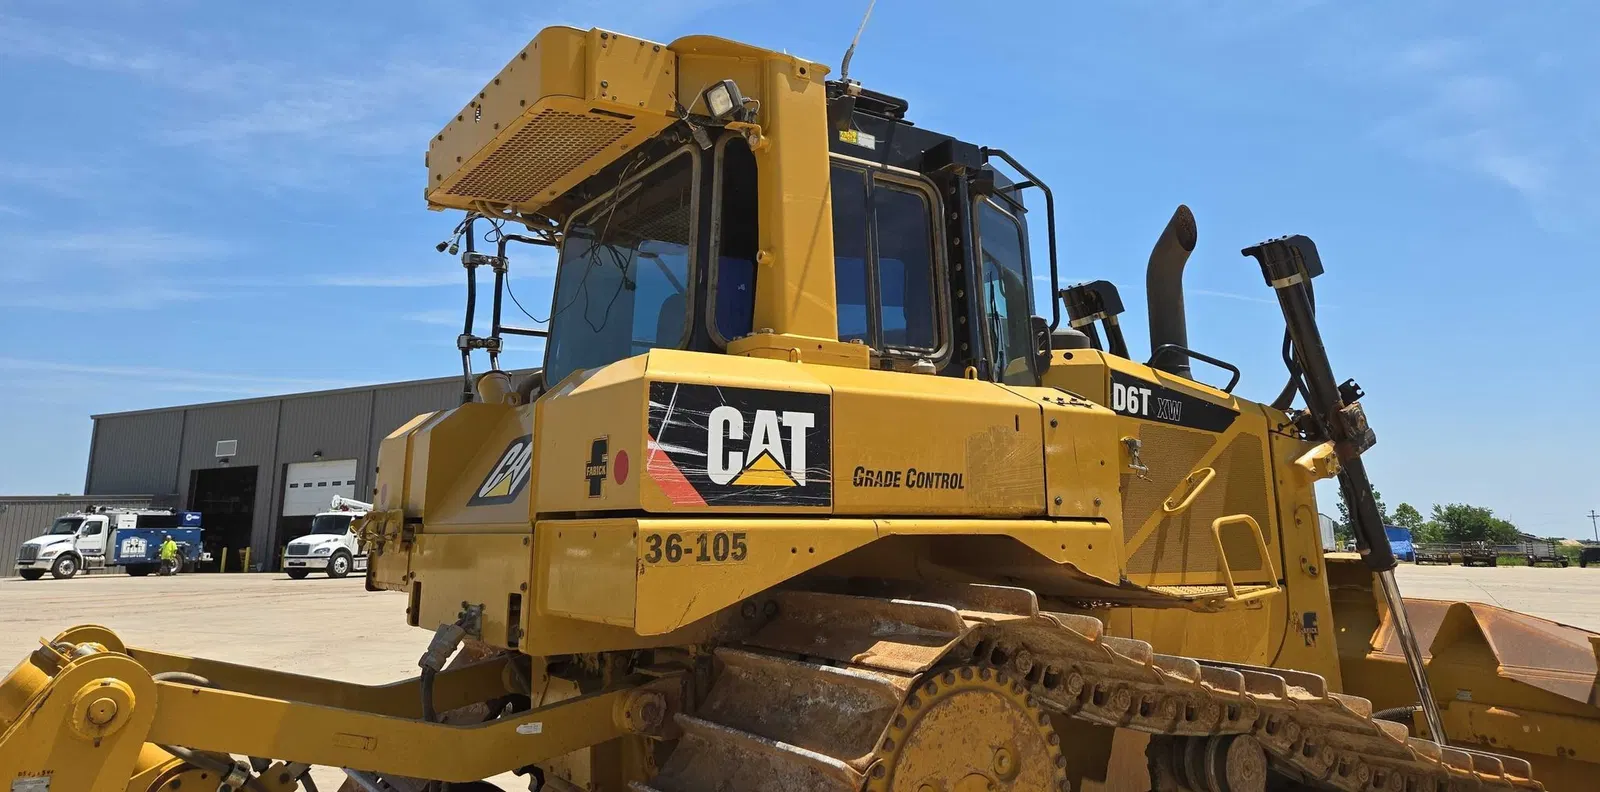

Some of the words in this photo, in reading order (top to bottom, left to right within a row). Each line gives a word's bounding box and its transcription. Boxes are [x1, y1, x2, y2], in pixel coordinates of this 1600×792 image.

[1113, 382, 1152, 416] D6T
[1157, 397, 1182, 421] XW
[707, 405, 815, 487] CAT
[586, 465, 606, 477] FABICK
[852, 465, 902, 489] GRADE
[905, 468, 965, 490] CONTROL
[644, 532, 748, 564] 36-105
